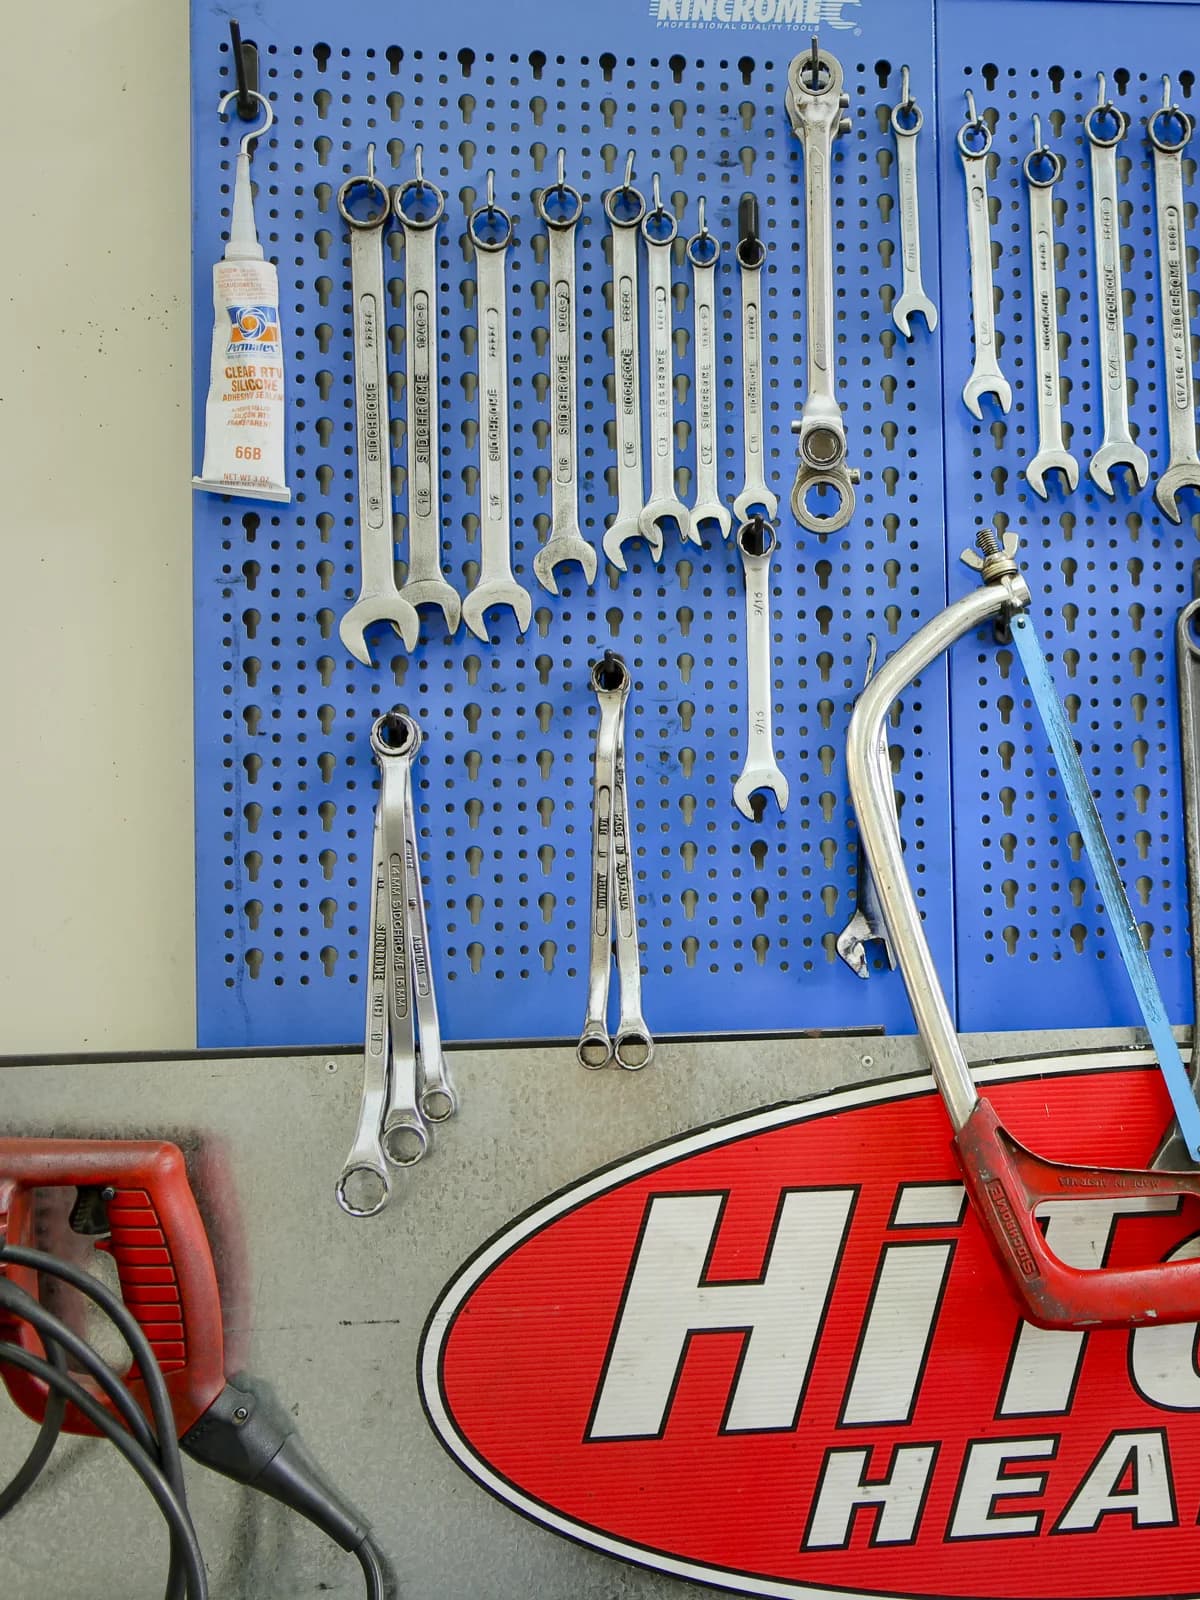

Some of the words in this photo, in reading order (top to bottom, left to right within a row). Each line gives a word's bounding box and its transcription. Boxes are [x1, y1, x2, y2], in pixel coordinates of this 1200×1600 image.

[655, 0, 823, 24] KINCROME
[656, 21, 737, 30] PROFESSIONAL
[740, 22, 783, 31] QUALITY
[786, 23, 821, 32] TOOLS
[1104, 264, 1117, 332] SIDCHROME
[1168, 259, 1183, 340] SIDCHROME
[224, 365, 257, 379] CLEAR
[231, 378, 279, 392] SILICONE
[557, 354, 570, 436] SIDCHROME
[620, 347, 634, 416] SIDCHROME
[700, 363, 712, 430] SIDCHROME
[365, 382, 380, 462] SIDCHROME
[414, 373, 430, 464] SIDCHROME
[487, 388, 501, 463] SIDCHROME
[235, 445, 262, 461] 66B
[559, 457, 569, 472] 16
[751, 710, 766, 736] 9/16
[614, 811, 625, 838] MADE
[616, 843, 627, 855] IN
[616, 860, 629, 911] AUSTRALIA
[372, 923, 387, 981] SIDCHROME
[392, 899, 406, 971] SIDCHROME
[989, 1181, 1038, 1277] SIDCHROME
